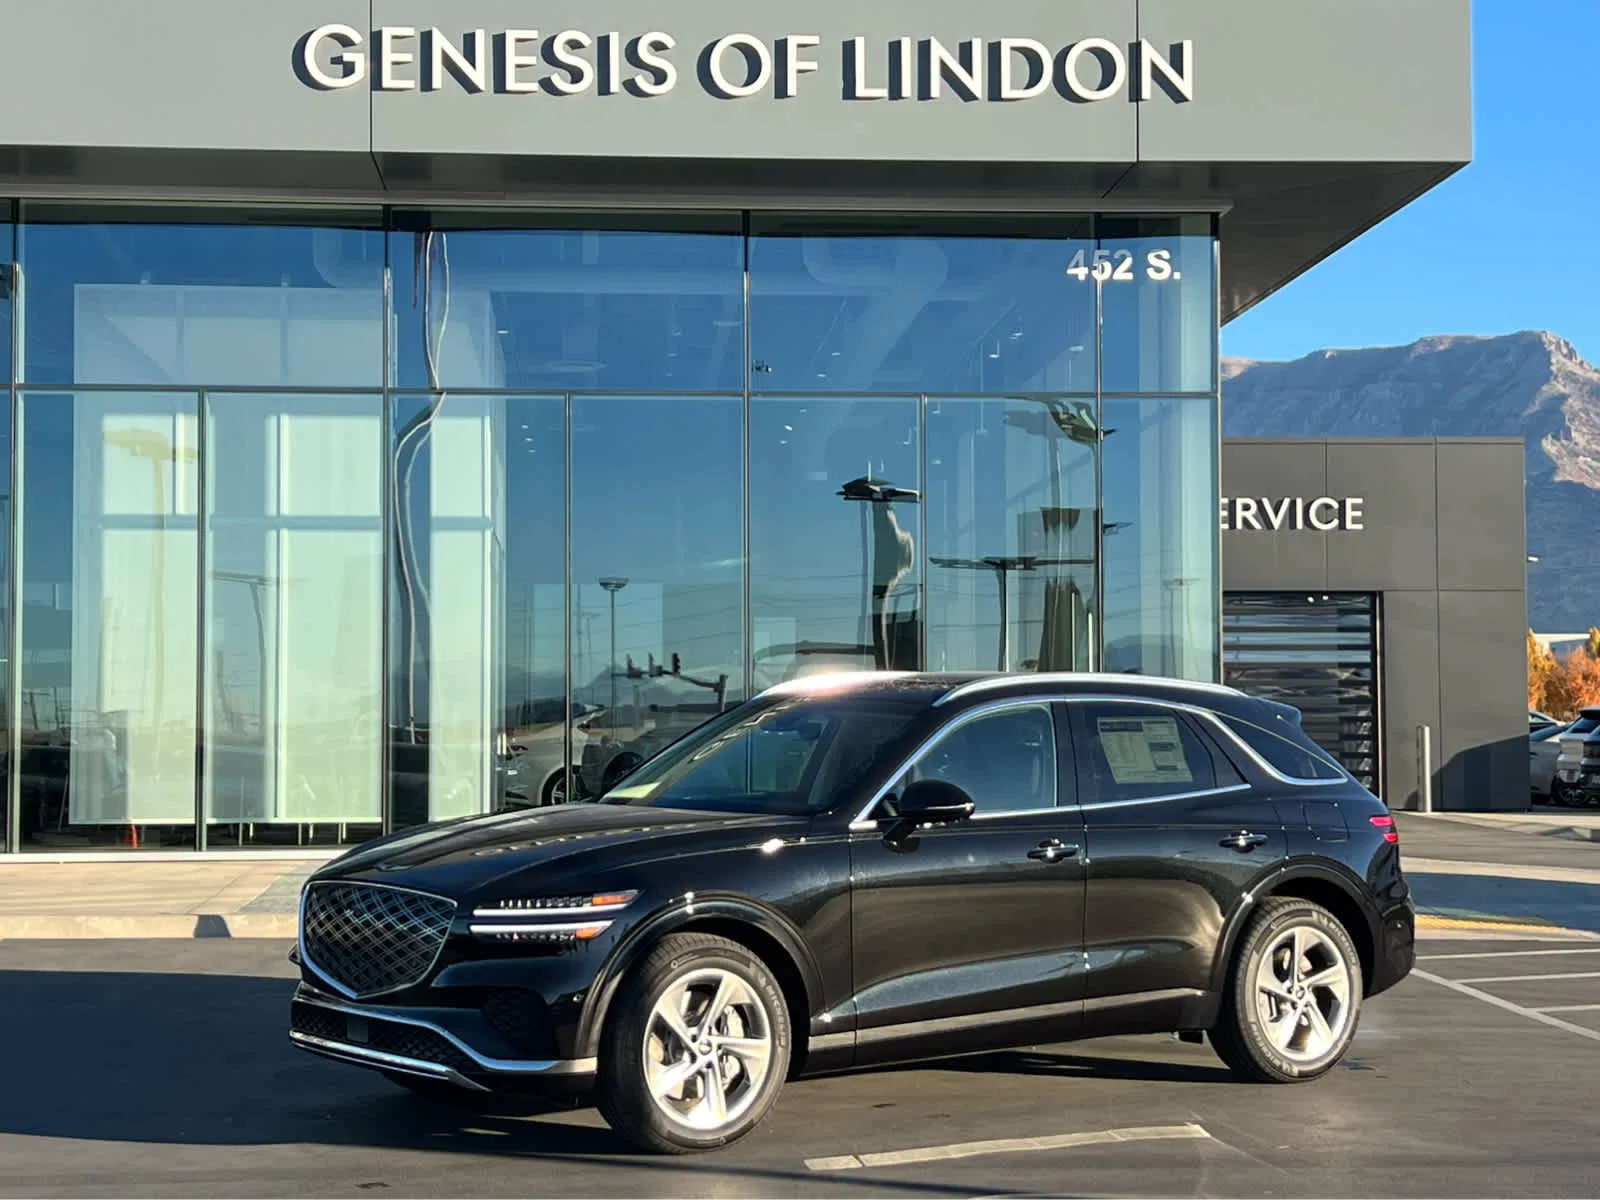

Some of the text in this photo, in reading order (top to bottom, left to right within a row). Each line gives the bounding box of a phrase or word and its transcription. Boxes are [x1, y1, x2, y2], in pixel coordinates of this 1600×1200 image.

[303, 23, 1193, 102] GENESIS OF LINDON
[1066, 249, 1181, 281] 452 S.
